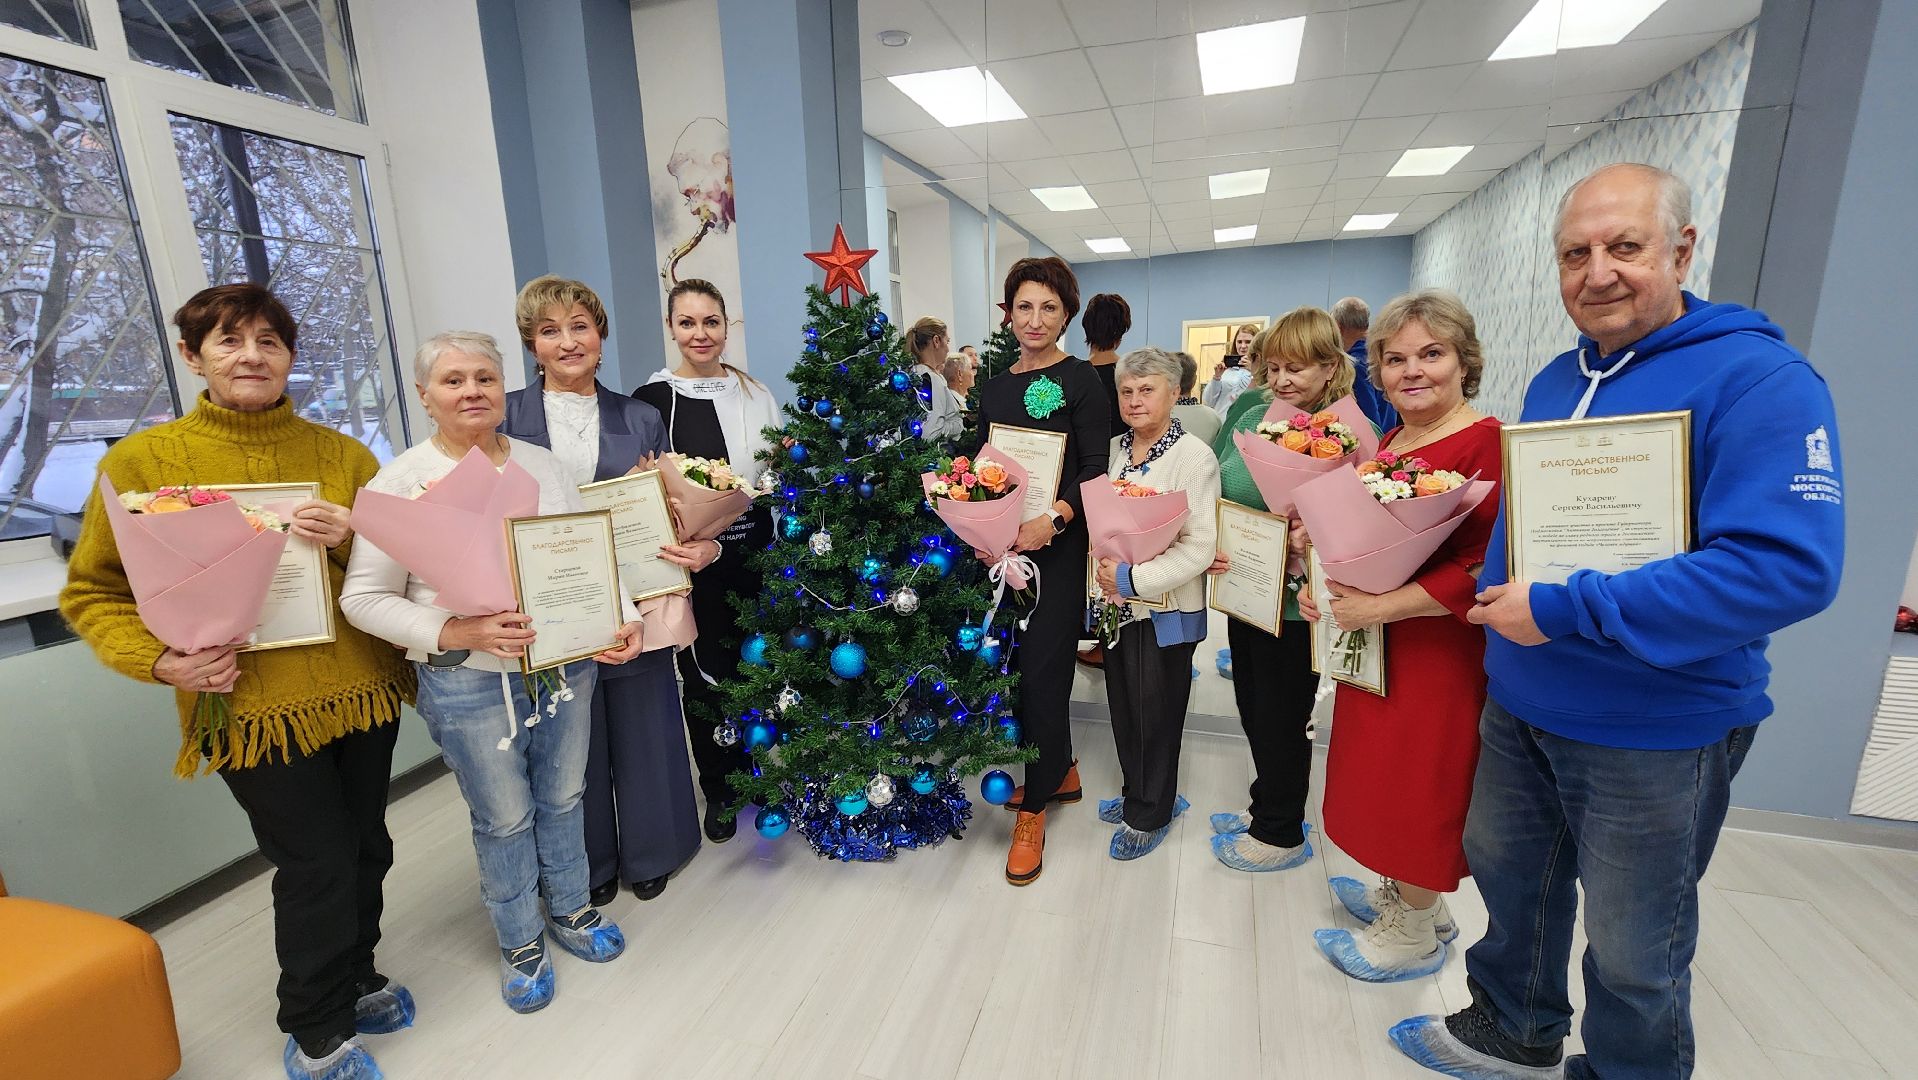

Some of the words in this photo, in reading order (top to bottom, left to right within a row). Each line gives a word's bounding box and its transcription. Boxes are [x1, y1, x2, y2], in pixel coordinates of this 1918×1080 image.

[1540, 453, 1651, 469] БЛАГОДАРСТВЕННОЕ
[1571, 466, 1619, 476] ПИСЬМО
[1576, 495, 1617, 504] Кухареву
[1552, 504, 1584, 513] Сергею
[1586, 503, 1642, 511] Васильевичу
[724, 522, 755, 532] VERYBODY
[726, 532, 747, 541] HAPPY
[532, 537, 595, 550] БЛАГОДАРСТВЕННОЕ
[550, 546, 578, 555] ПИСЬМО
